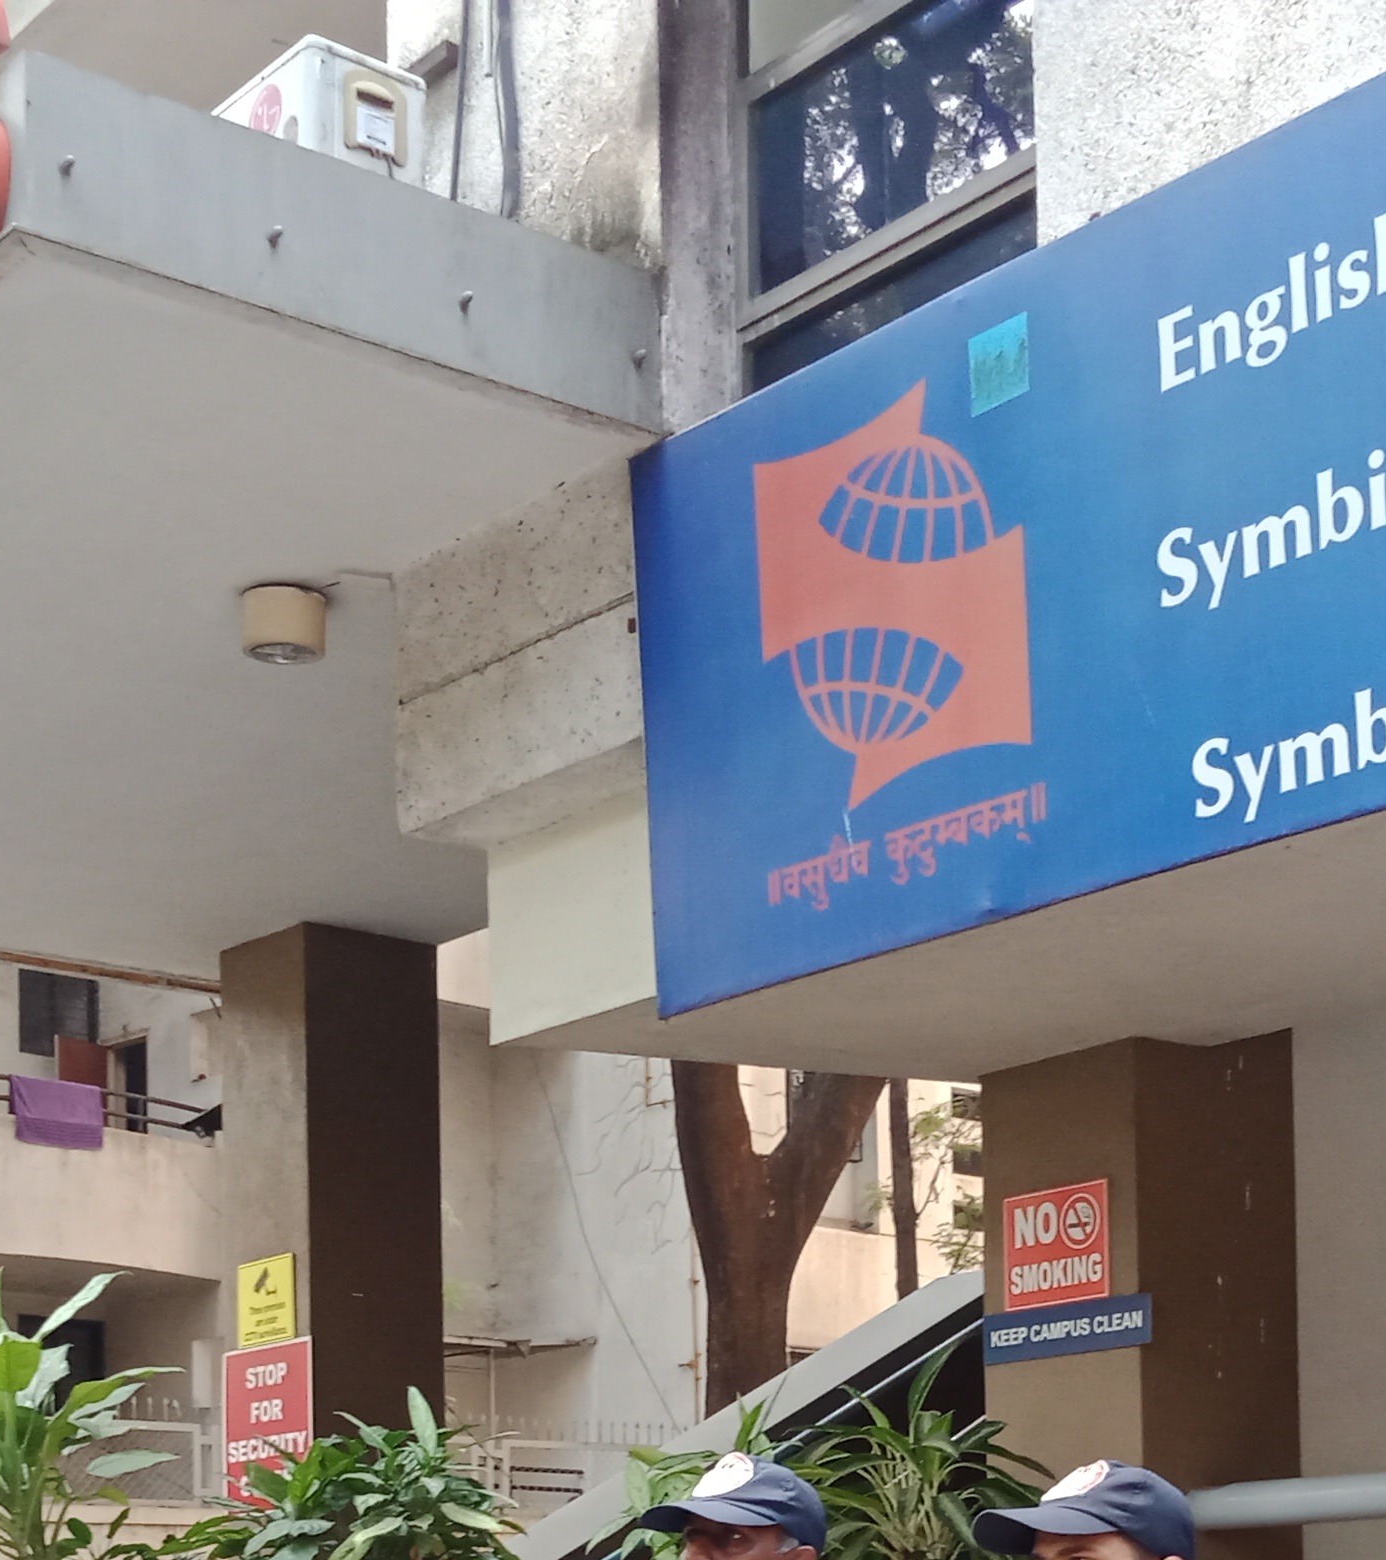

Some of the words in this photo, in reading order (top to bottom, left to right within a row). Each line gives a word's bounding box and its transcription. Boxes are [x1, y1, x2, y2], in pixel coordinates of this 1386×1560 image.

[1013, 1201, 1059, 1250] NO
[1009, 1252, 1103, 1296] SMOKING
[989, 1326, 1028, 1348] KEEP
[1029, 1317, 1091, 1342] CAMPUS
[1092, 1309, 1144, 1334] CLEAN
[245, 1361, 288, 1390] STOP
[249, 1398, 284, 1425] FOR
[227, 1430, 308, 1464] SECURITY
